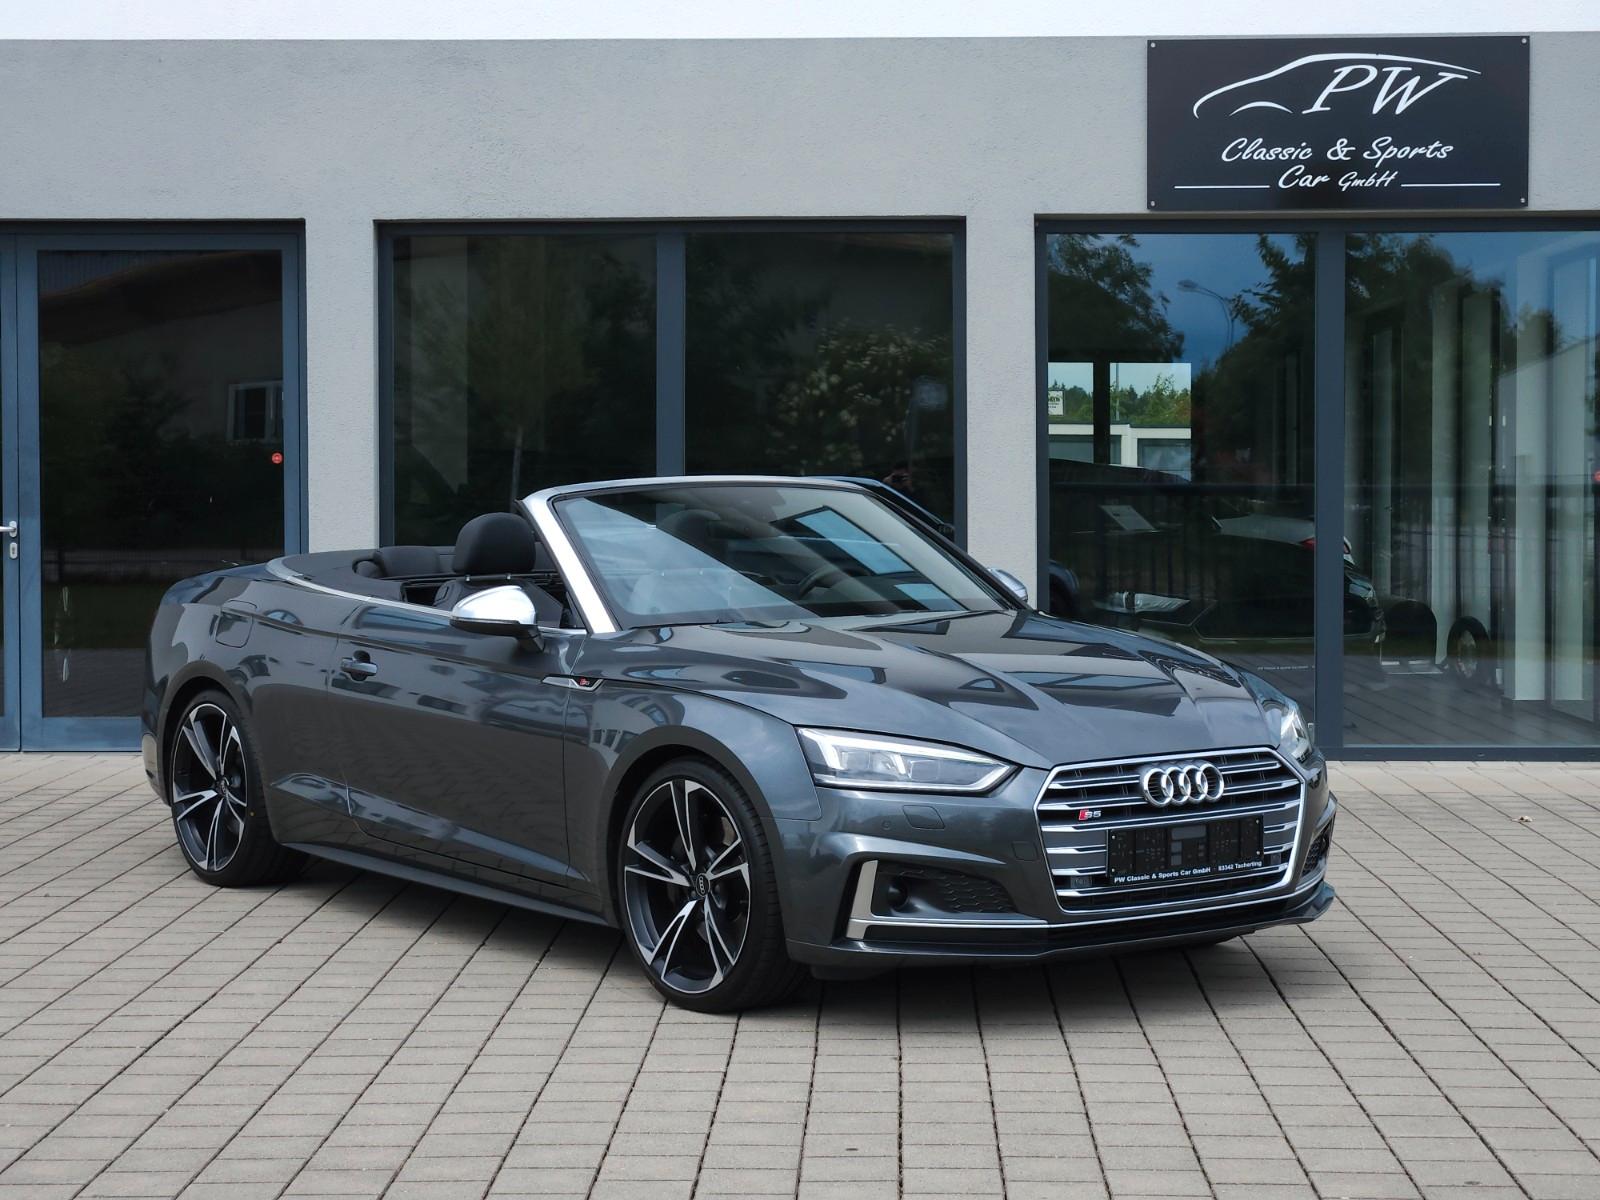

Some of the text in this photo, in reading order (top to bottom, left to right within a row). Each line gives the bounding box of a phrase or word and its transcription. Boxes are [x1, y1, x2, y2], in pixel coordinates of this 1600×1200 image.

[1302, 64, 1468, 115] PW
[1221, 136, 1454, 167] Classic & Sports
[1278, 164, 1398, 191] Car GmbH
[1114, 876, 1126, 884] PW
[1126, 873, 1151, 882] Classic
[1158, 870, 1180, 879] Sports
[1192, 866, 1212, 874] GmbH
